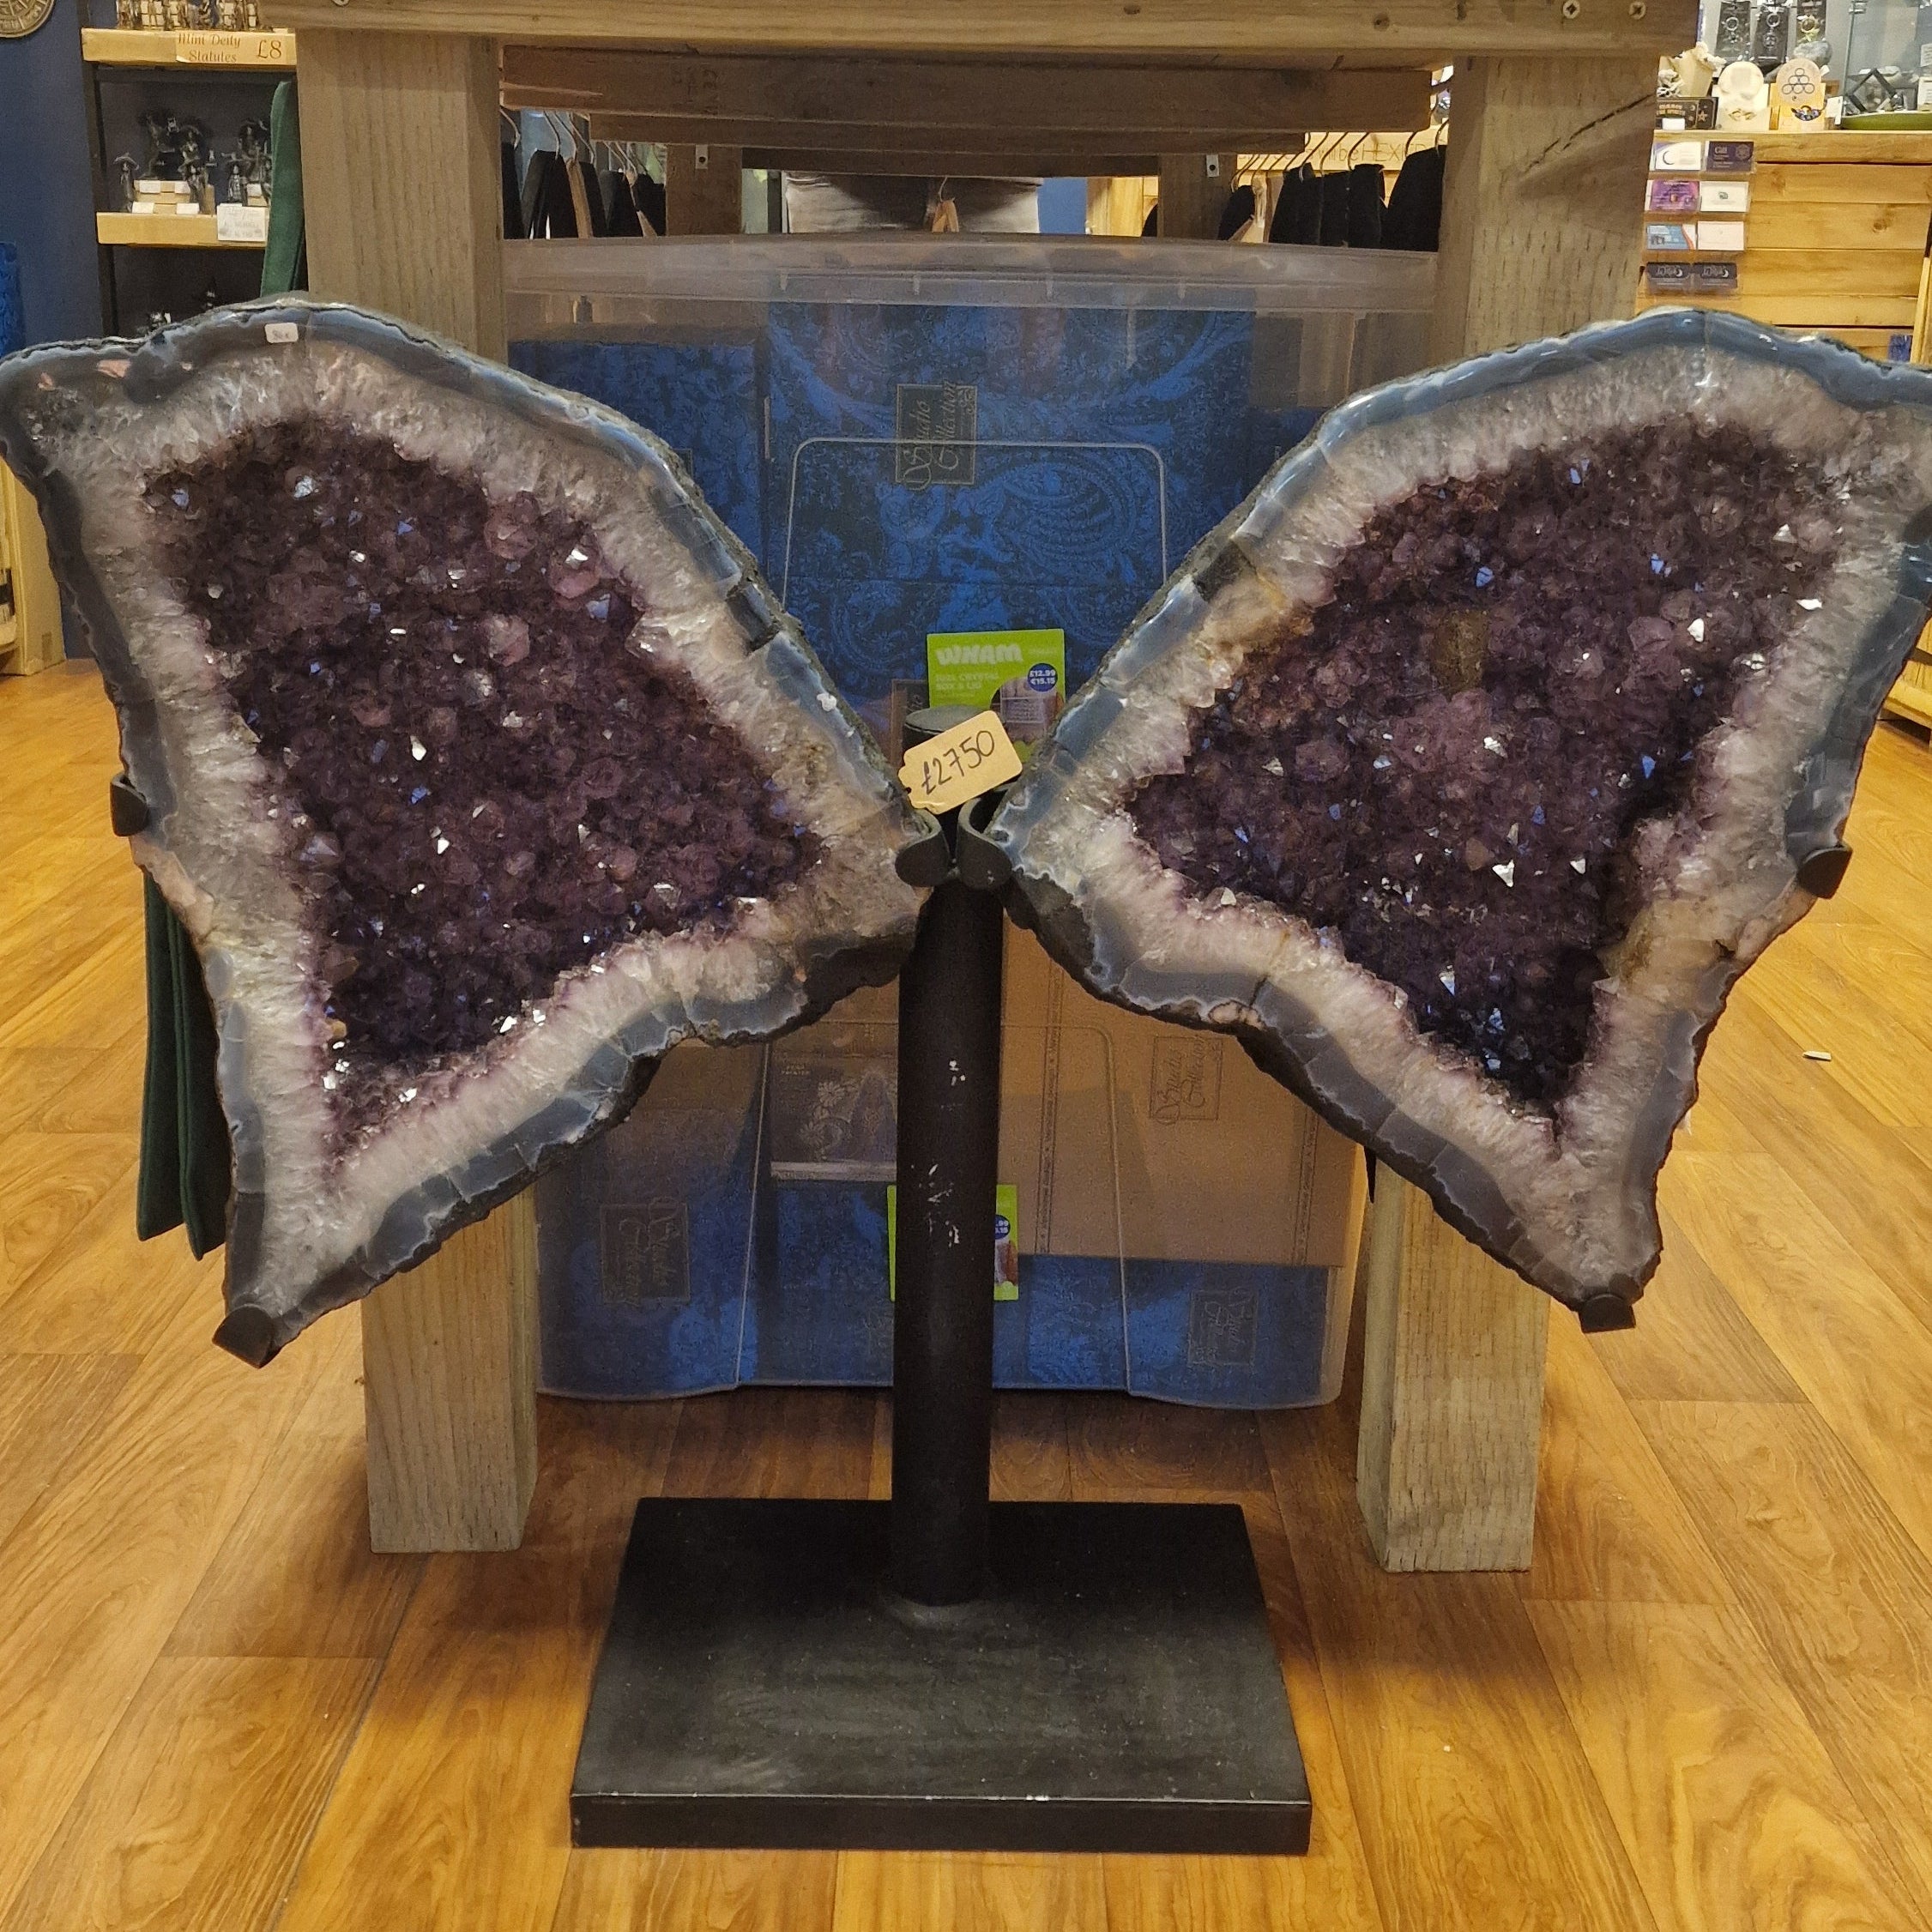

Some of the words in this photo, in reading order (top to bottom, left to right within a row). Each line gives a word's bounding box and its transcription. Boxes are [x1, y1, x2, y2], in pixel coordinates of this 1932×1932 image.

[211, 34, 241, 49] Deity
[257, 39, 282, 59] £8
[935, 644, 1023, 666] WHAM
[1029, 669, 1056, 678] £12.99
[921, 730, 994, 794] £2750
